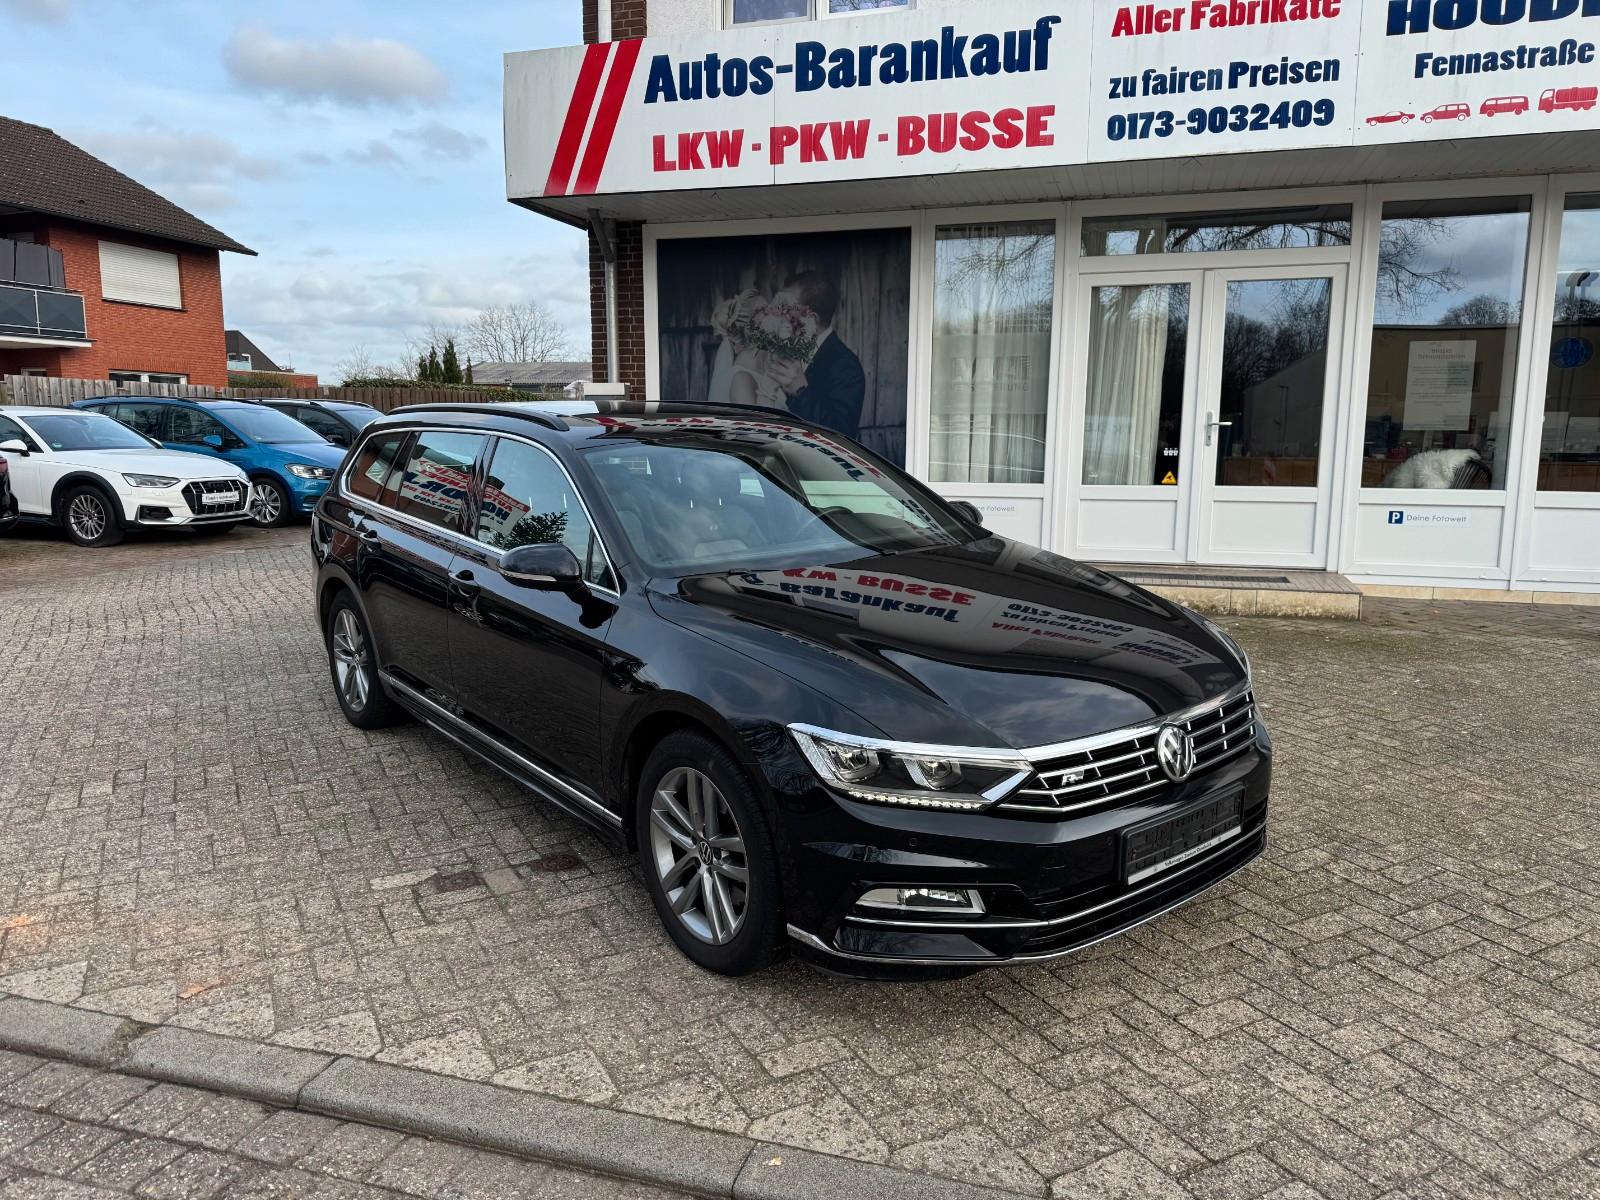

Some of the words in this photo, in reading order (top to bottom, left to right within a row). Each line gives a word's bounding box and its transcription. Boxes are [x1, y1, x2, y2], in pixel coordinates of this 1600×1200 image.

[1112, 5, 1185, 37] Aller
[1190, 0, 1341, 31] Fabrikate
[1386, 0, 1600, 36] HOUD
[644, 15, 1062, 106] Autos-Barankauf
[1109, 76, 1138, 100] zu
[1142, 67, 1222, 97] fairen
[1228, 57, 1340, 90] Preisen
[1414, 39, 1595, 79] Fennastraße
[653, 129, 744, 173] LKW
[770, 119, 871, 166] PKW
[897, 105, 1056, 156] BUSSE
[1107, 97, 1335, 141] 0173-9032409
